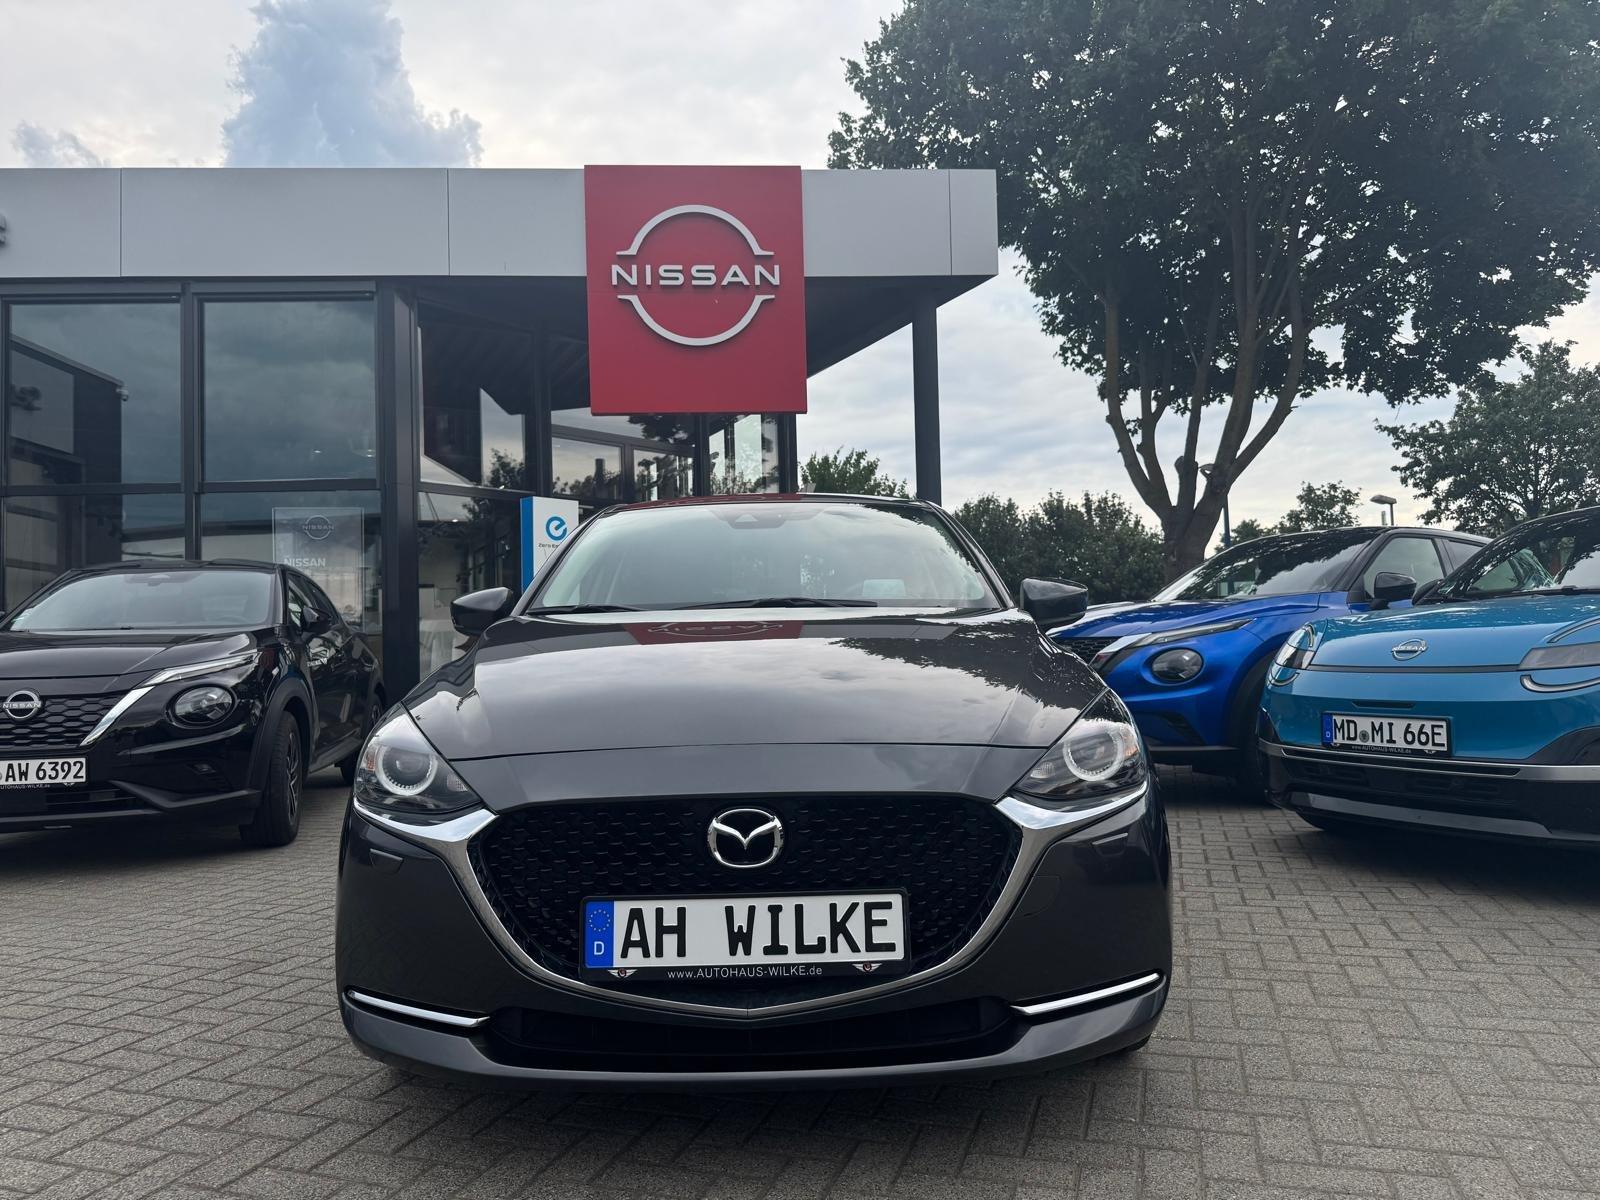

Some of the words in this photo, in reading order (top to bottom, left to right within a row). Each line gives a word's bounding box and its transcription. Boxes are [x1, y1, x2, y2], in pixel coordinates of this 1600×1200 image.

[611, 264, 780, 286] NISSAN
[284, 558, 326, 567] NISSAN
[1333, 718, 1358, 741] MD
[1371, 721, 1397, 744] MI
[1403, 723, 1446, 747] 66E
[5, 762, 29, 782] AW
[35, 761, 84, 781] 6392
[620, 906, 687, 959] AH
[724, 900, 897, 957] WILKE
[594, 941, 605, 955] D
[667, 965, 823, 979] www.AUTOHAUS-WILKE.de
